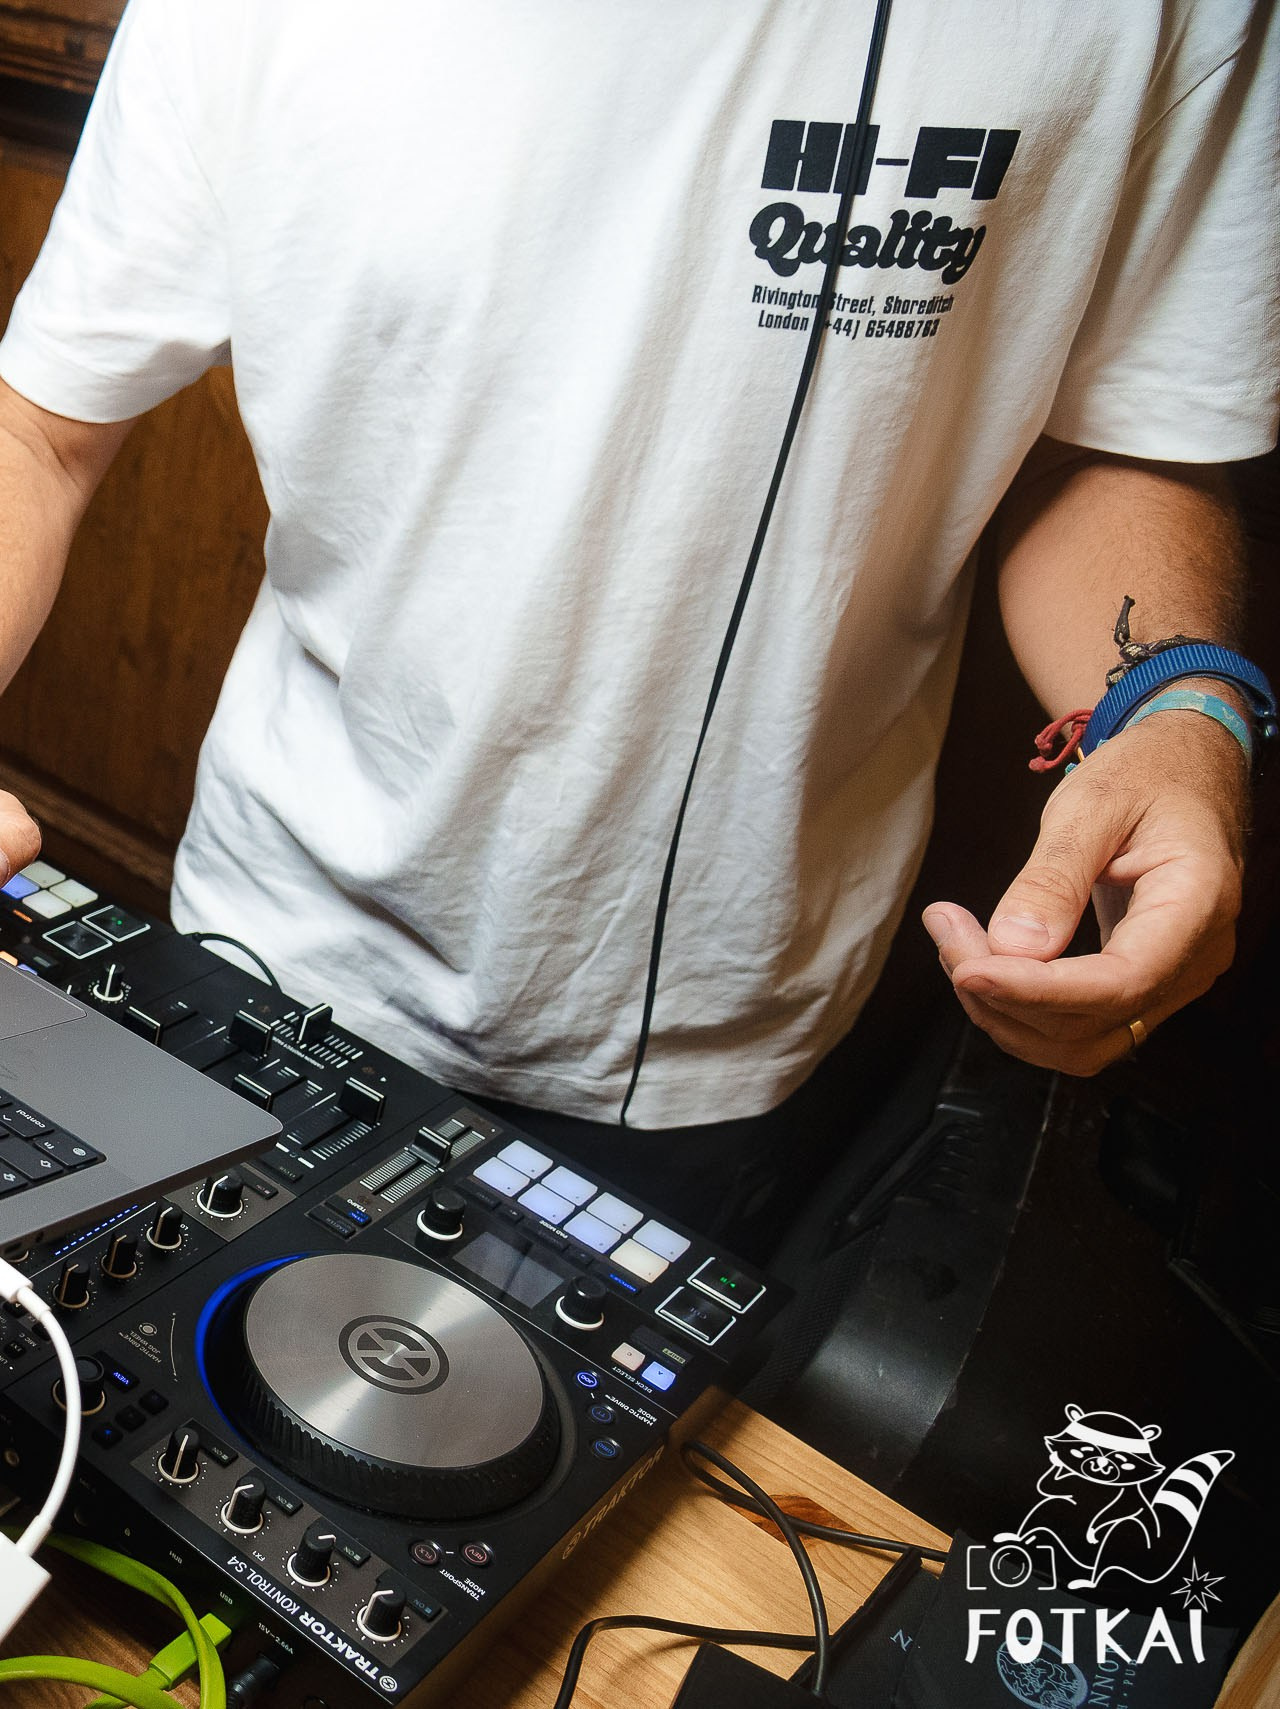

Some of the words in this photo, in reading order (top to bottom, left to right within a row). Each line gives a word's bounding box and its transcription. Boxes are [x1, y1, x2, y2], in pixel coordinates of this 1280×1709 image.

[761, 120, 1021, 200] HI-FI
[749, 202, 987, 285] Quality
[752, 285, 821, 309] Rivington
[828, 292, 876, 316] Street,
[883, 295, 955, 316] Shoreditch
[758, 310, 809, 331] London
[823, 319, 860, 340] +44)
[16, 1109, 46, 1129] control
[347, 1199, 367, 1213] TEMPO
[662, 1348, 685, 1364] SHIFT
[113, 1370, 129, 1386] VIEW
[612, 1366, 639, 1384] SELECT
[637, 1382, 653, 1394] DECK
[630, 1407, 654, 1426] HAPTIC
[637, 1408, 657, 1423] MODE
[227, 1555, 253, 1576] S4
[251, 1550, 266, 1562] FX1
[241, 1570, 301, 1616] KONTROL
[439, 1568, 484, 1600] TRANSPORT
[464, 1577, 486, 1595] MODE
[300, 1605, 381, 1681] TRAKTOR
